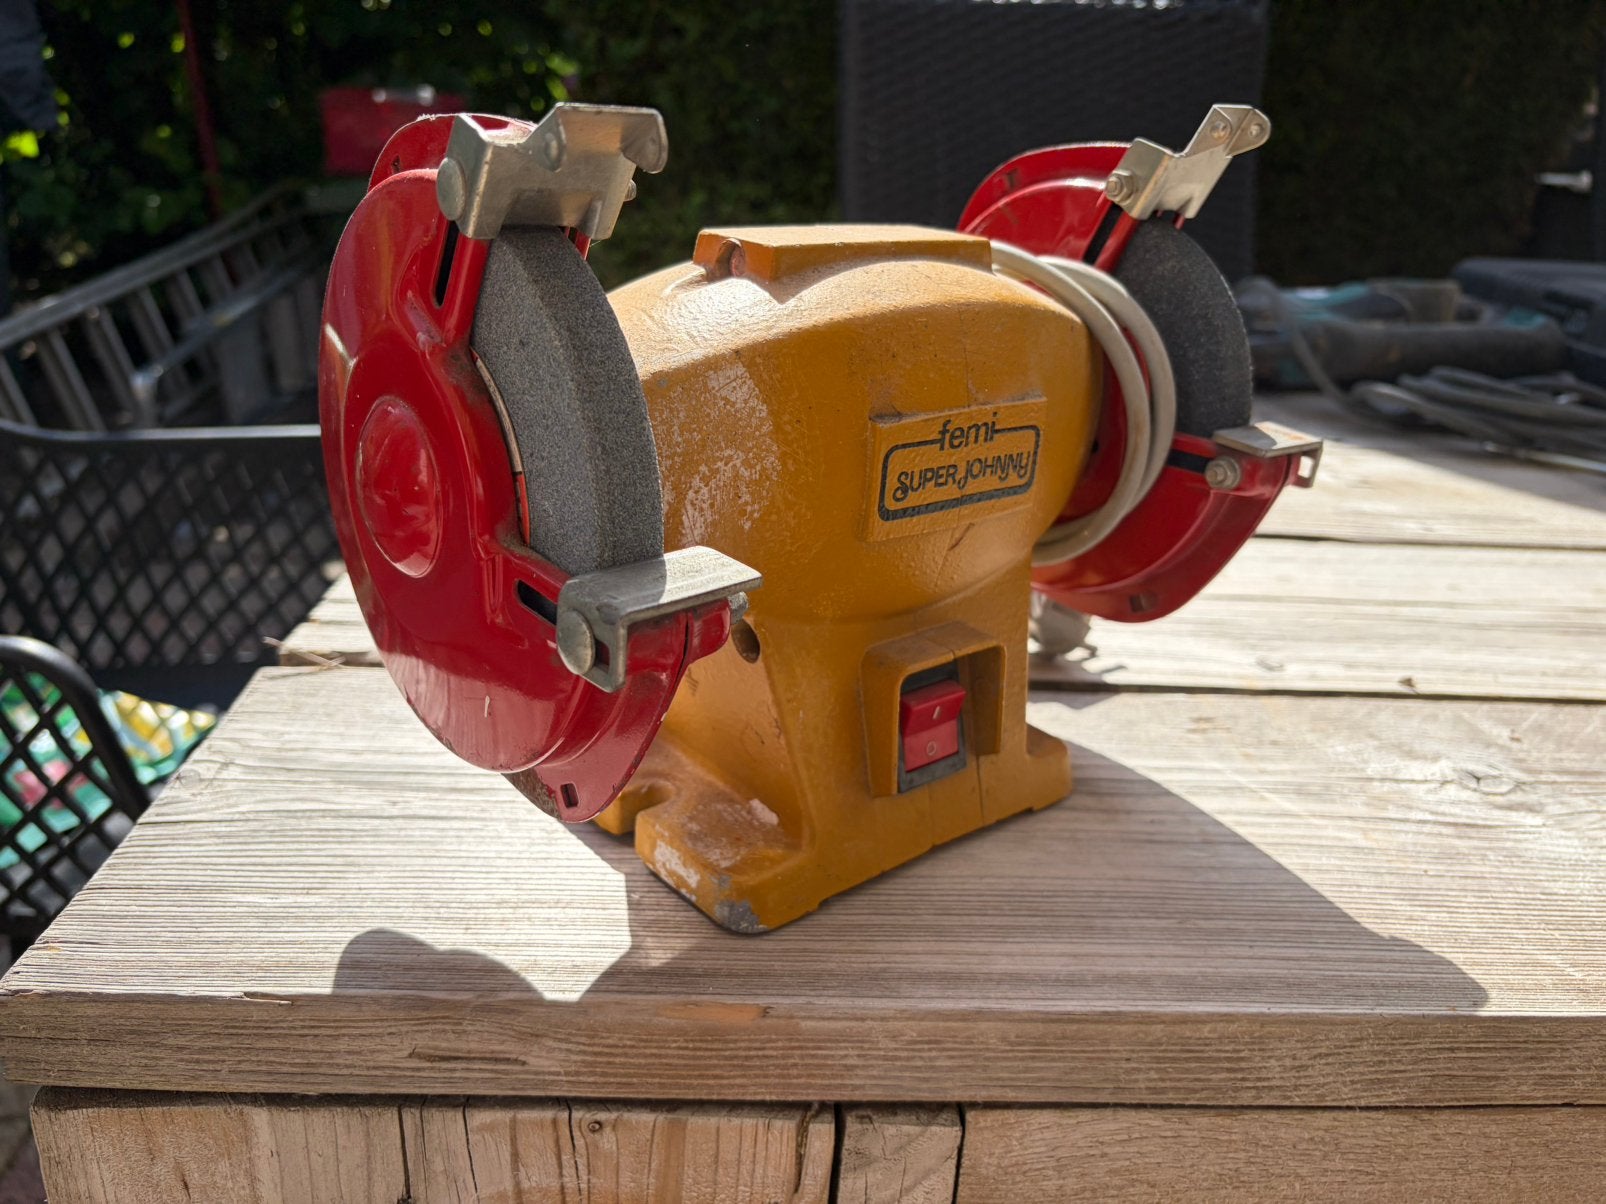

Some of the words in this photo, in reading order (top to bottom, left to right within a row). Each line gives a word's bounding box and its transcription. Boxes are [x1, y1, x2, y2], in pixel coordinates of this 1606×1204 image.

[938, 412, 998, 451] femi
[893, 464, 959, 502] SUPER
[957, 451, 1031, 490] JOHNNY
